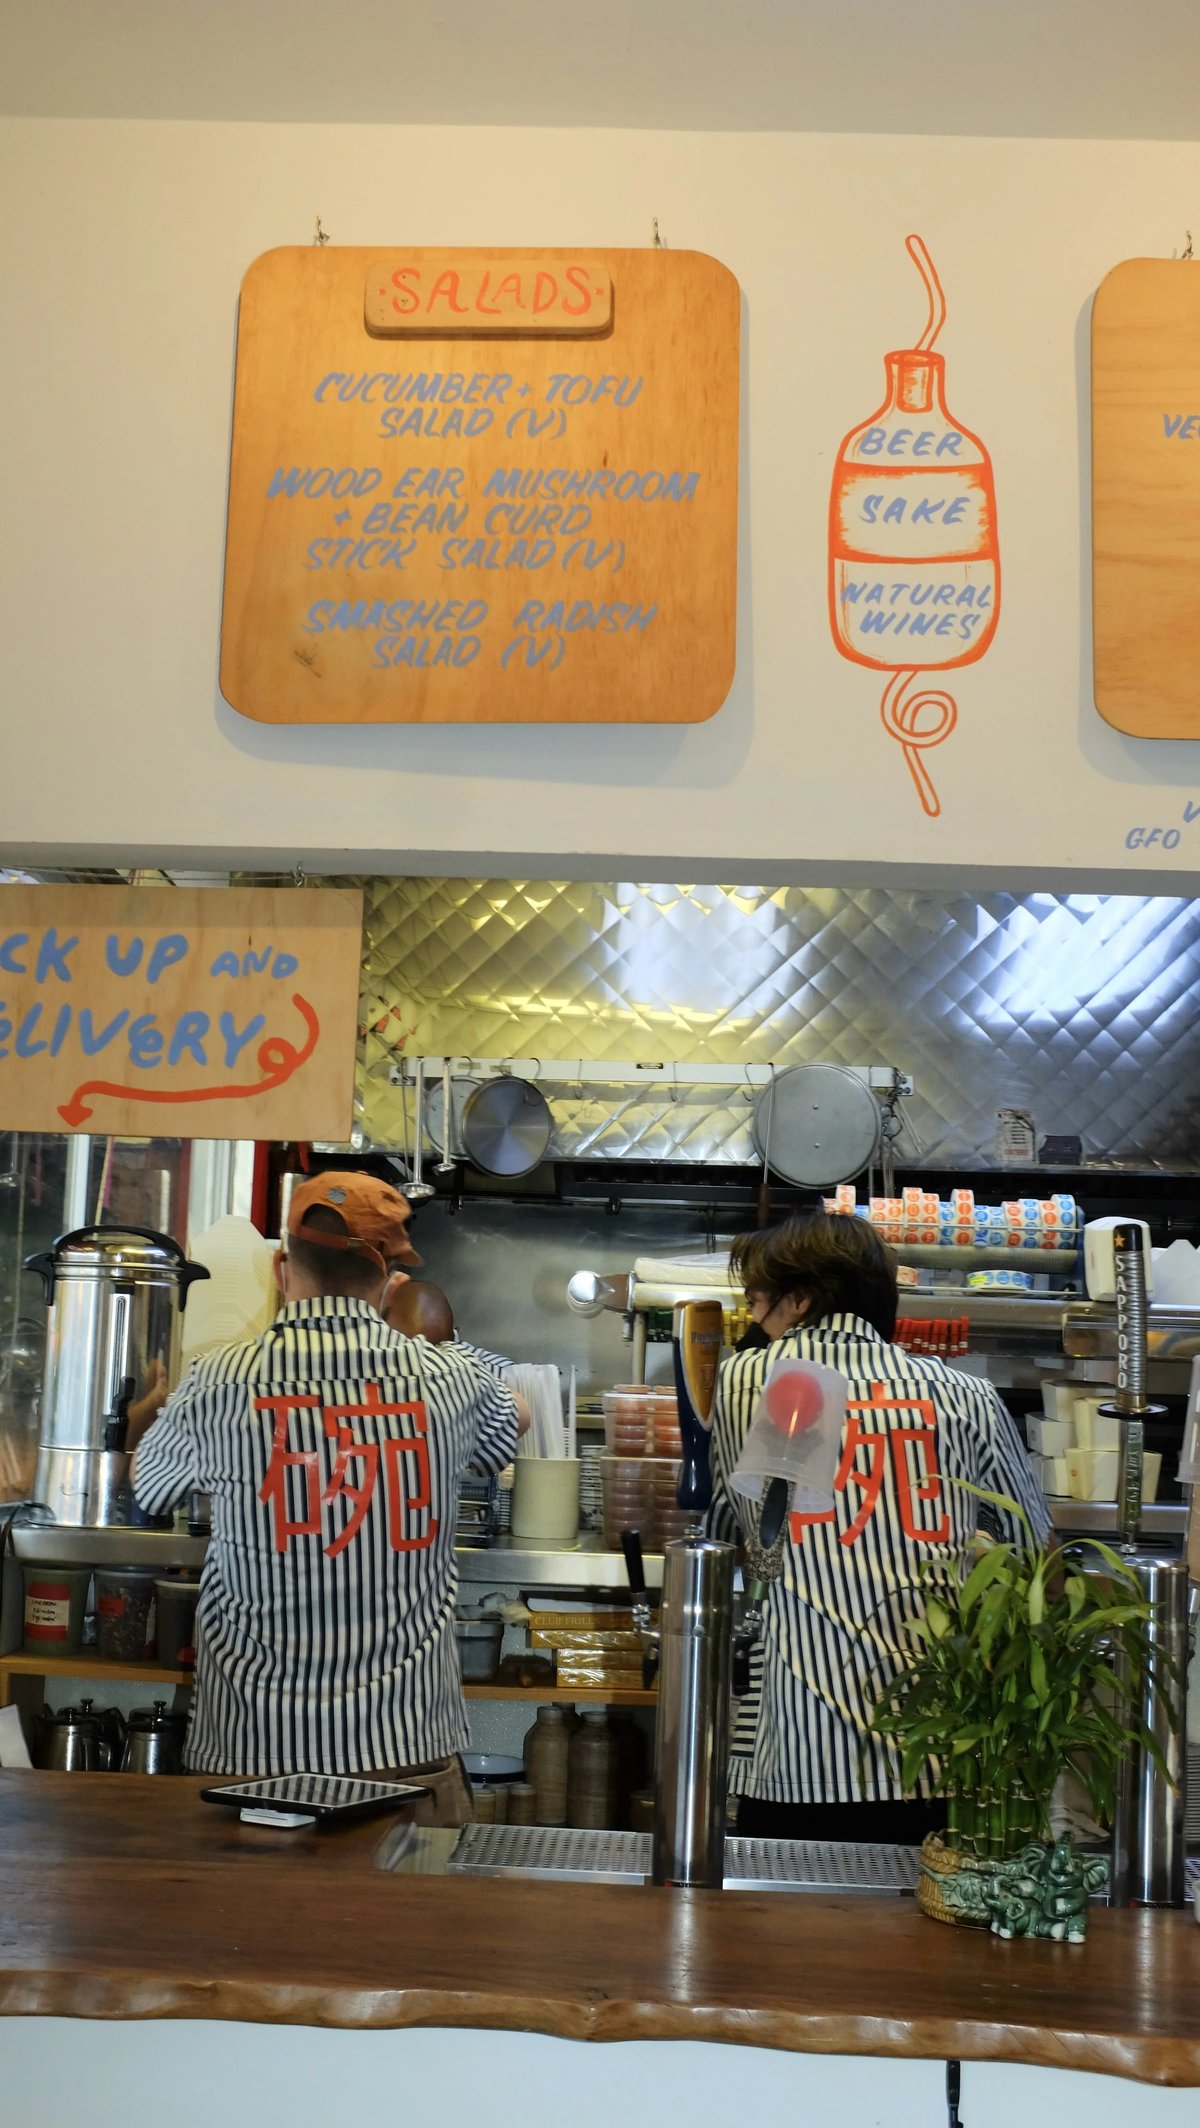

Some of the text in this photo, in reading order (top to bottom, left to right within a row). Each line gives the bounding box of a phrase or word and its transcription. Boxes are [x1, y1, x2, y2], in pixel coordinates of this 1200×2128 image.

[390, 266, 593, 316] SALADS
[312, 371, 514, 404] CUCUMBER
[545, 373, 646, 408] TOFU
[378, 407, 568, 441] SALAD (V)
[859, 427, 964, 457] BEER
[1162, 413, 1200, 440] VE
[266, 466, 701, 504] WOOD EAR MUSHROOM
[361, 502, 469, 535] BEAN
[483, 502, 593, 536] CURD
[860, 494, 971, 526] SAKE
[302, 536, 418, 572] STICK
[436, 537, 556, 571] SALAD
[840, 581, 992, 608] NATURAL
[302, 598, 659, 636] SMASHED RADISH
[859, 610, 981, 641] WINES
[370, 634, 567, 672] SALAD (V)
[1124, 826, 1181, 850] GFO
[105, 932, 190, 985] UP
[209, 945, 299, 980] AND
[1114, 1254, 1129, 1389] SAPPORO
[253, 1382, 439, 1560] 碗
